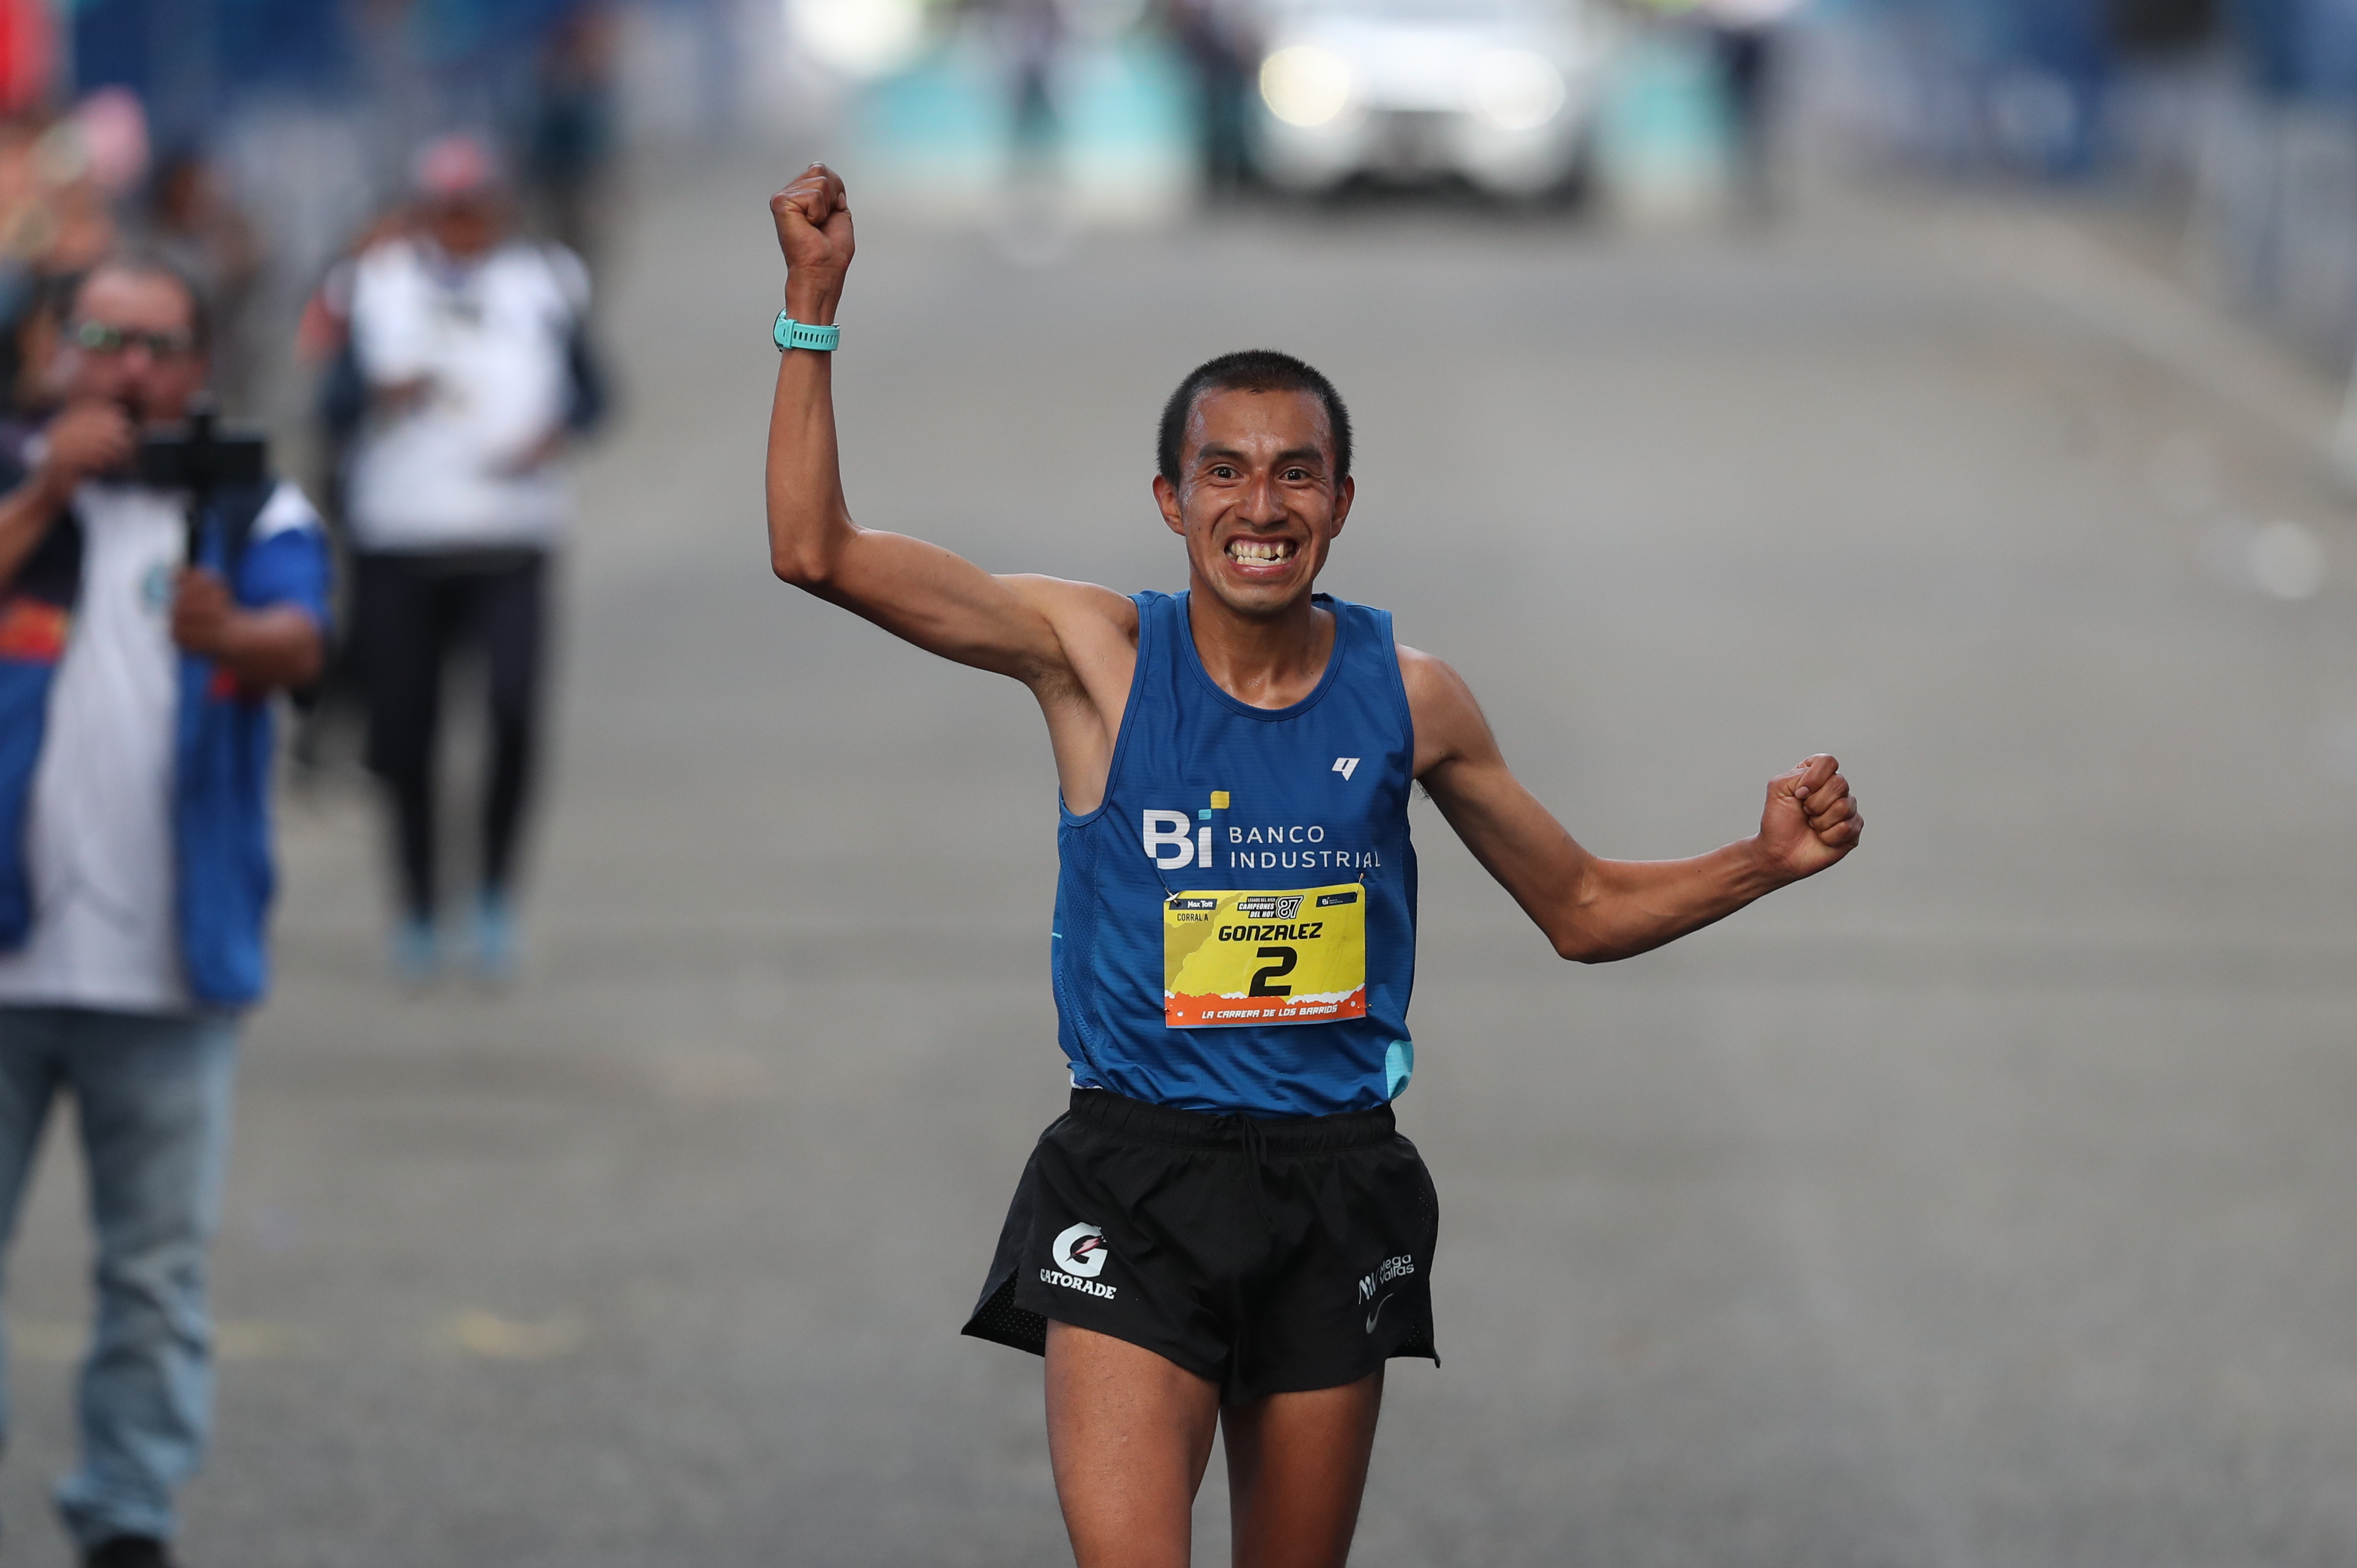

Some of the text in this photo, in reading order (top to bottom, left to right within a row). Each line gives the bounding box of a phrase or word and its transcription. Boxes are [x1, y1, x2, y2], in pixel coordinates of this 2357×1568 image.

[1143, 809, 1212, 870] Bi
[1229, 826, 1325, 844] BANCO
[1230, 851, 1381, 869] INDUSTRIAL
[1277, 895, 1304, 919] 87
[1219, 922, 1323, 941] GONZALEZ
[1249, 946, 1297, 997] 2
[1202, 1004, 1338, 1019] LA CARRERA DE LOS BARRIOS
[1380, 1254, 1412, 1275] Mega
[1040, 1268, 1117, 1300] GATORADE
